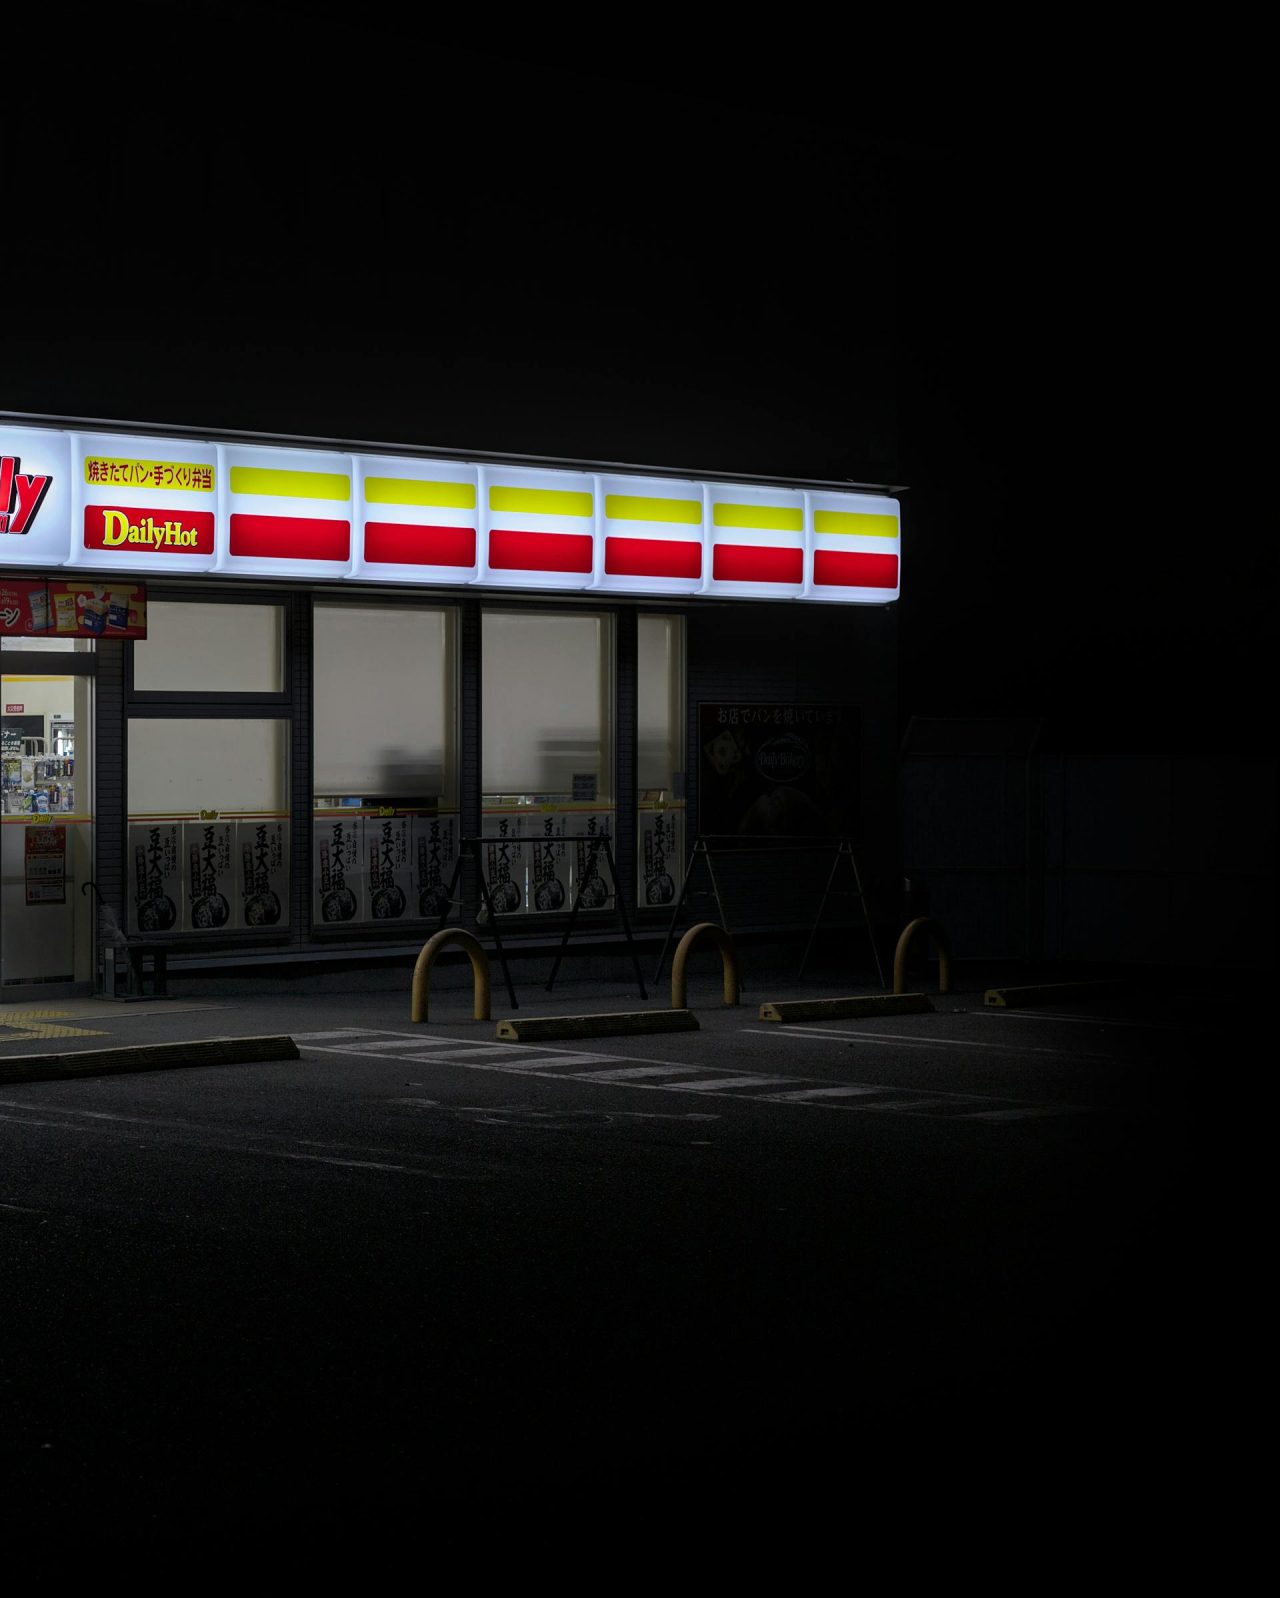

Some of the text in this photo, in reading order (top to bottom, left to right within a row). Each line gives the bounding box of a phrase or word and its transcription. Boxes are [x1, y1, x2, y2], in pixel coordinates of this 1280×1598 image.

[87, 460, 212, 490] 焼きたてパン・手づくり弁当
[102, 510, 199, 550] DailyHot
[148, 827, 163, 898] 豆大福
[201, 825, 217, 897] 豆大福
[254, 825, 270, 894] 豆大福
[331, 822, 345, 890] 豆大福
[381, 821, 394, 888] 豆大福
